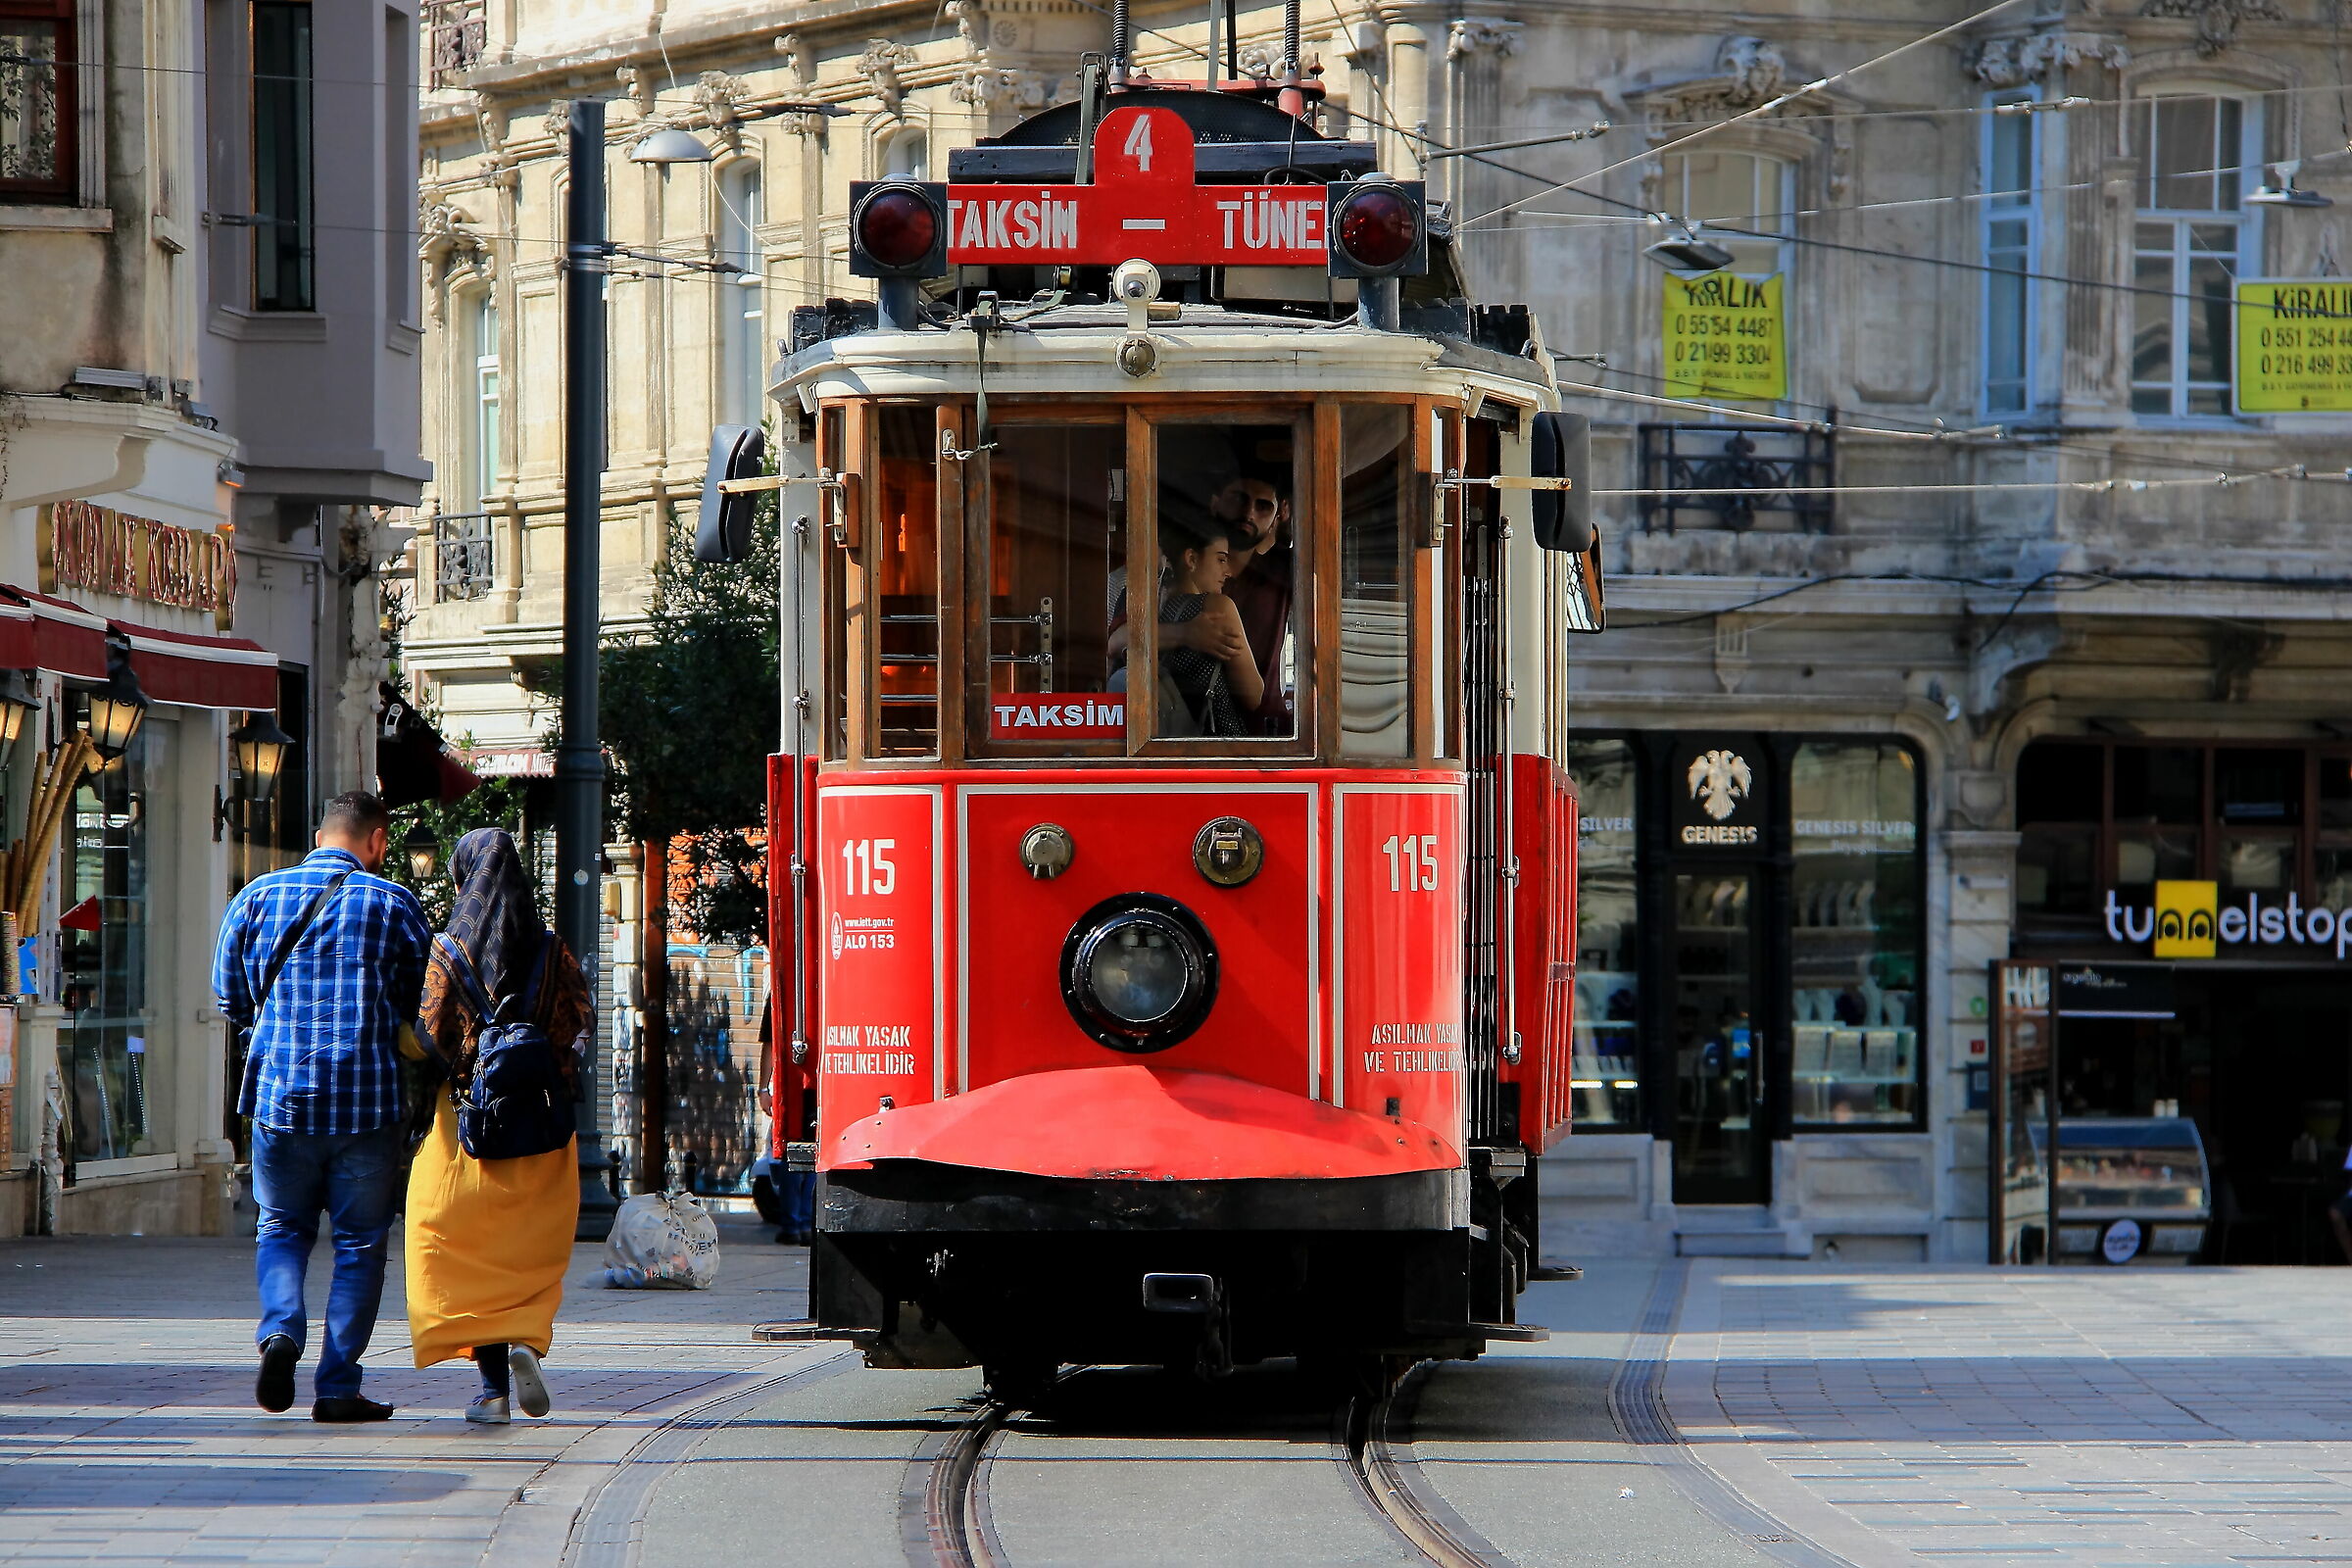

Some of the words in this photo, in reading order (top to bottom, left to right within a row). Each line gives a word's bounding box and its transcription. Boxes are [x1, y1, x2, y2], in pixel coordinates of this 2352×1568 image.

[1124, 114, 1153, 172] 4
[947, 190, 1077, 249] TAKSİM
[1676, 314, 1686, 334] 0
[2261, 327, 2272, 348] 0
[2276, 327, 2302, 348] 551
[2307, 327, 2334, 348] 254
[1674, 341, 1685, 362] 0
[2261, 355, 2272, 374] 0
[2276, 355, 2303, 374] 216
[994, 700, 1125, 727] TAKSİM
[1579, 816, 1634, 832] SILVER
[1794, 820, 1859, 835] GENESIS
[1681, 825, 1758, 846] GENESIS
[843, 839, 896, 896] 115
[1382, 835, 1439, 893] 115
[844, 916, 895, 929] www.iett.gov.tr
[844, 934, 868, 950] ALO
[869, 934, 895, 950] 153
[864, 1024, 911, 1048] YASAK
[1363, 1051, 1386, 1073] VE
